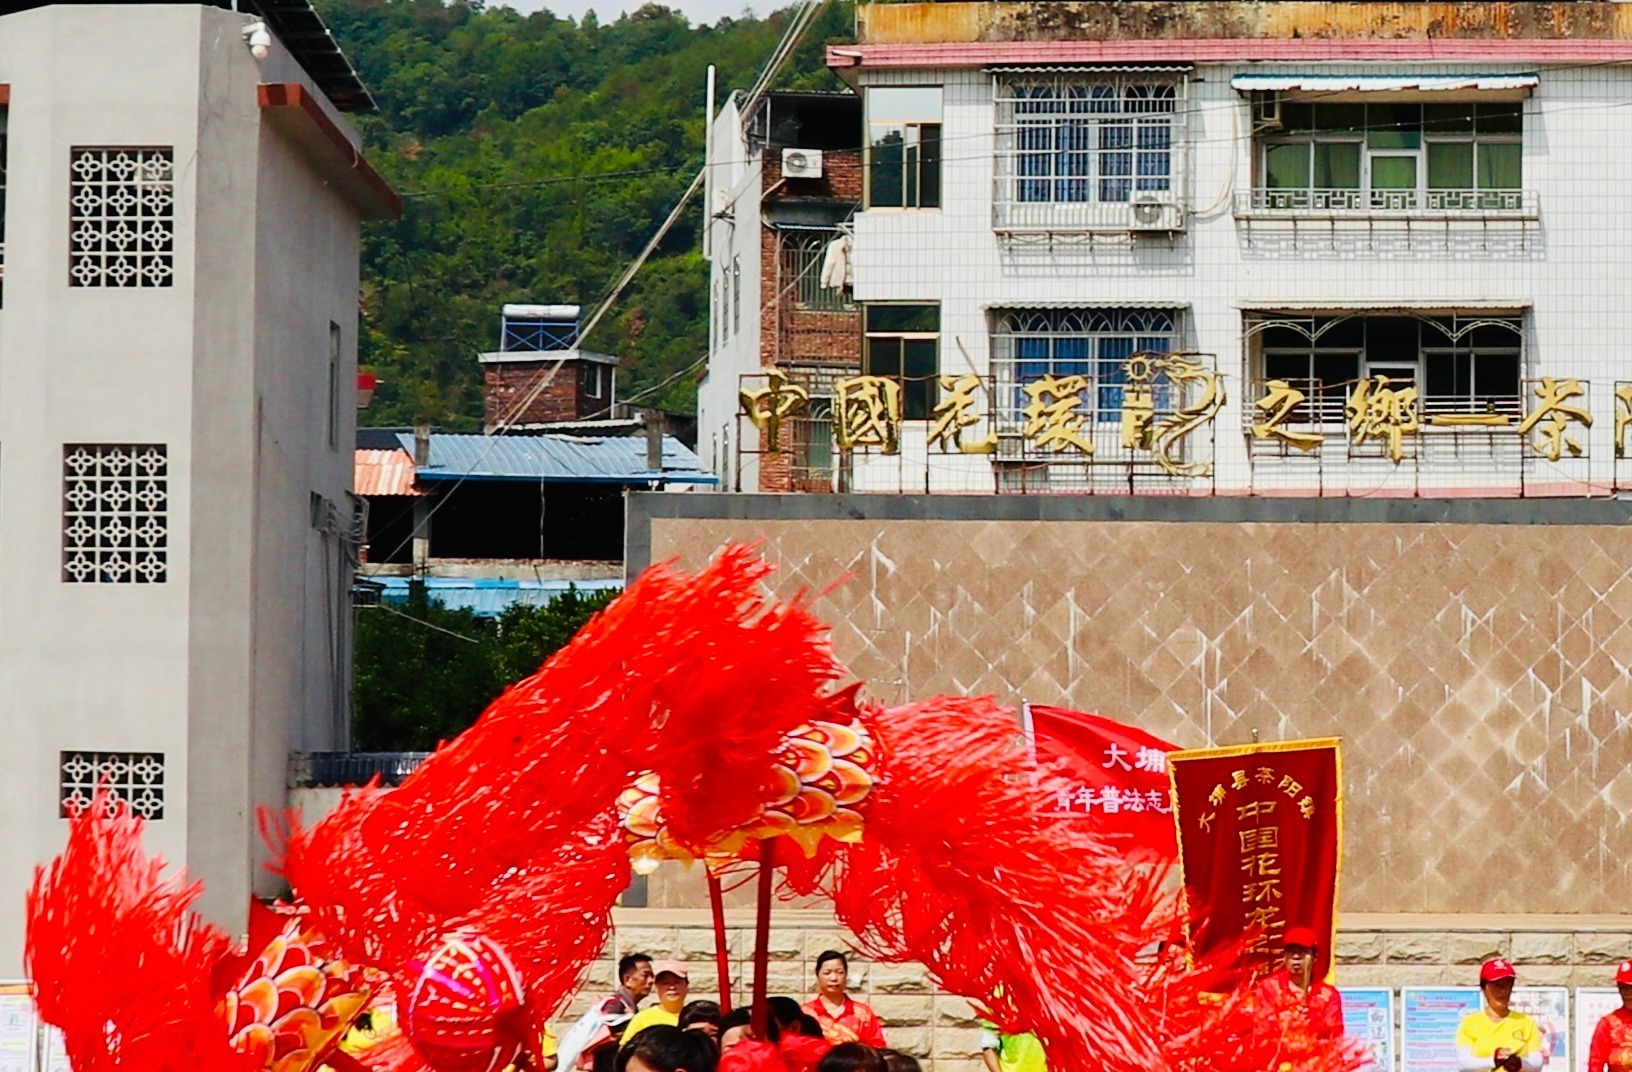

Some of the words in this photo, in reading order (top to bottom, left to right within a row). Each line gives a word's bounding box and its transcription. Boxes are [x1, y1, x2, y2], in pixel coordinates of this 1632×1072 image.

[1054, 785, 1174, 814] 青年普法志
